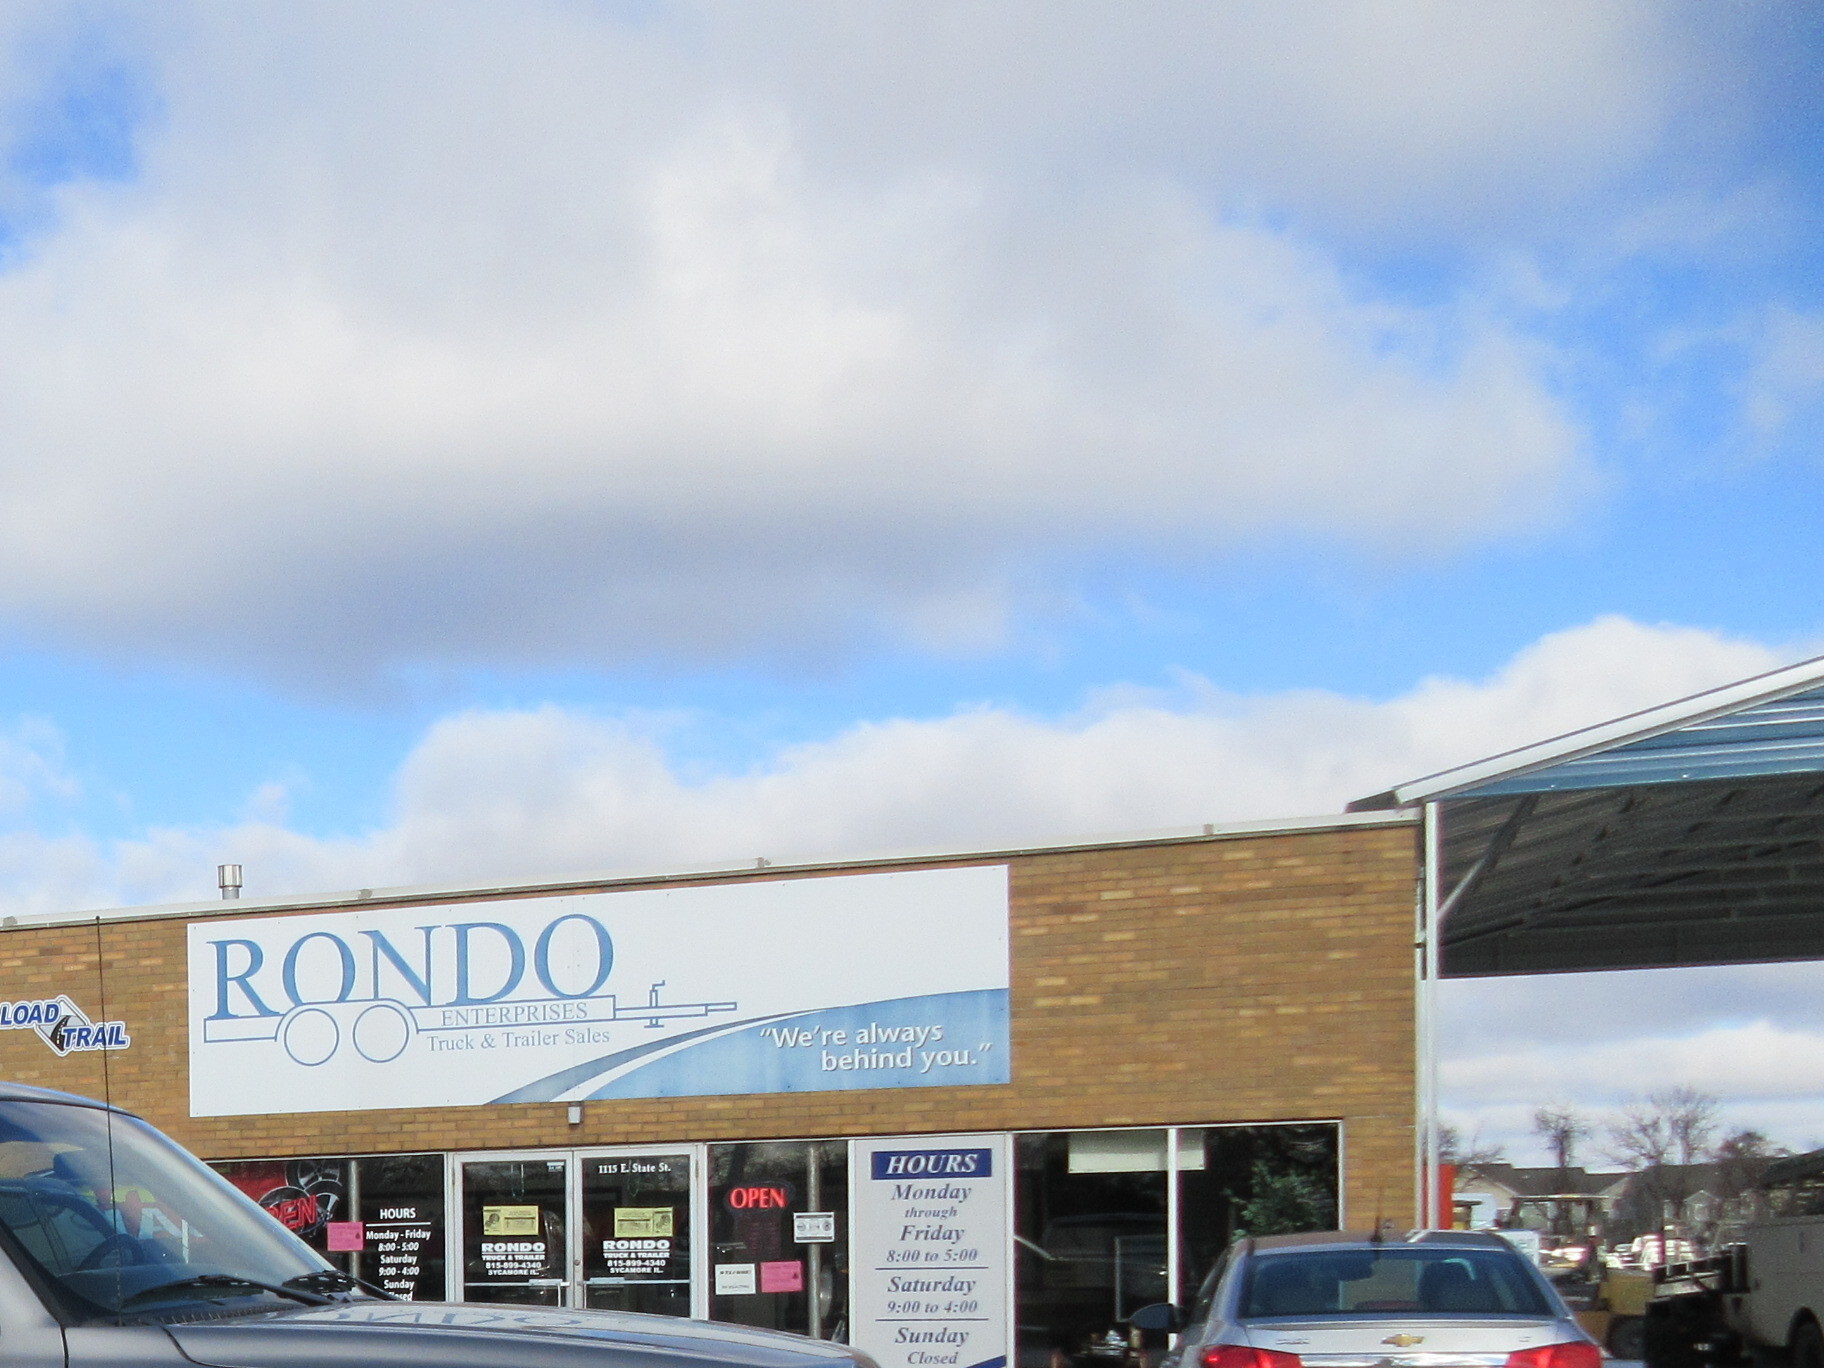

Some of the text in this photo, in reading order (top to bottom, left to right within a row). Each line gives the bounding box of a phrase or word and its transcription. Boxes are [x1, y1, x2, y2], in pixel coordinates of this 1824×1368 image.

[206, 913, 615, 1018] RONDO
[1, 1001, 61, 1025] LOAD
[441, 1001, 588, 1027] ENTERPRISES
[61, 1025, 126, 1048] TRAIL
[426, 1027, 611, 1052] Truck & Trailer Sales
[855, 1022, 944, 1049] always
[821, 1046, 913, 1072] behind
[598, 1165, 618, 1174] 1115
[632, 1162, 656, 1173] State
[658, 1162, 672, 1173] St.
[886, 1153, 978, 1175] HOURS
[730, 1187, 788, 1208] OPEN
[891, 1183, 972, 1203] Monday
[380, 1208, 416, 1219] HOURS
[905, 1206, 958, 1220] through
[366, 1230, 400, 1241] Monday
[405, 1229, 431, 1240] Friday
[898, 1225, 965, 1244] Friday
[378, 1243, 396, 1251] 8:00
[401, 1242, 419, 1251] 5:00
[482, 1242, 545, 1252] RONDO
[603, 1240, 670, 1249] RONDO
[380, 1254, 417, 1265] Saturday
[886, 1249, 978, 1263] 8:00 to 5:00
[379, 1267, 396, 1276] 9:00
[401, 1266, 420, 1275] 4:00
[384, 1279, 415, 1290] Sunday
[887, 1276, 976, 1296] Saturday
[887, 1300, 978, 1314] 9:00 to 4:00
[895, 1327, 969, 1347] Sunday
[907, 1351, 959, 1365] Closed
